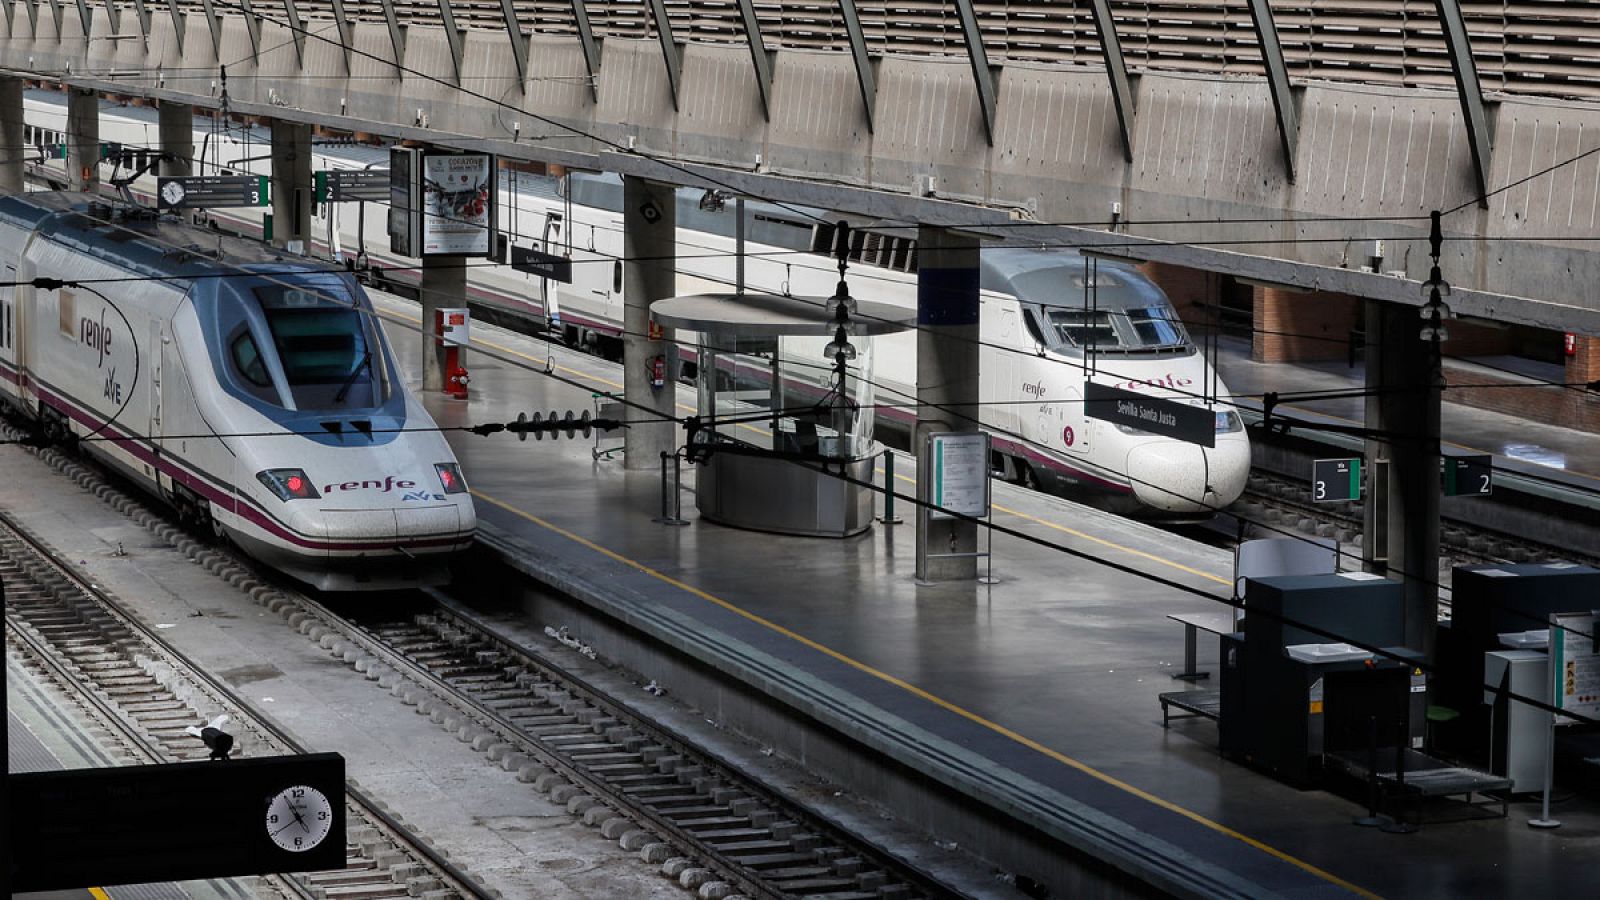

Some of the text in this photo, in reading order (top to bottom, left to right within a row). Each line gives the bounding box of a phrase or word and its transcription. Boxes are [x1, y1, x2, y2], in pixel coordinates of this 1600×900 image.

[251, 191, 259, 203] 3
[326, 186, 333, 199] 2
[81, 307, 112, 368] renfe
[1022, 379, 1046, 399] renfe
[1117, 400, 1176, 427] Sevilla Santa Justa
[324, 475, 416, 493] renfe
[1316, 480, 1326, 499] 3
[1480, 475, 1489, 493] 2
[292, 789, 305, 798] 12
[270, 811, 326, 824] 9 3
[294, 837, 302, 846] 6
